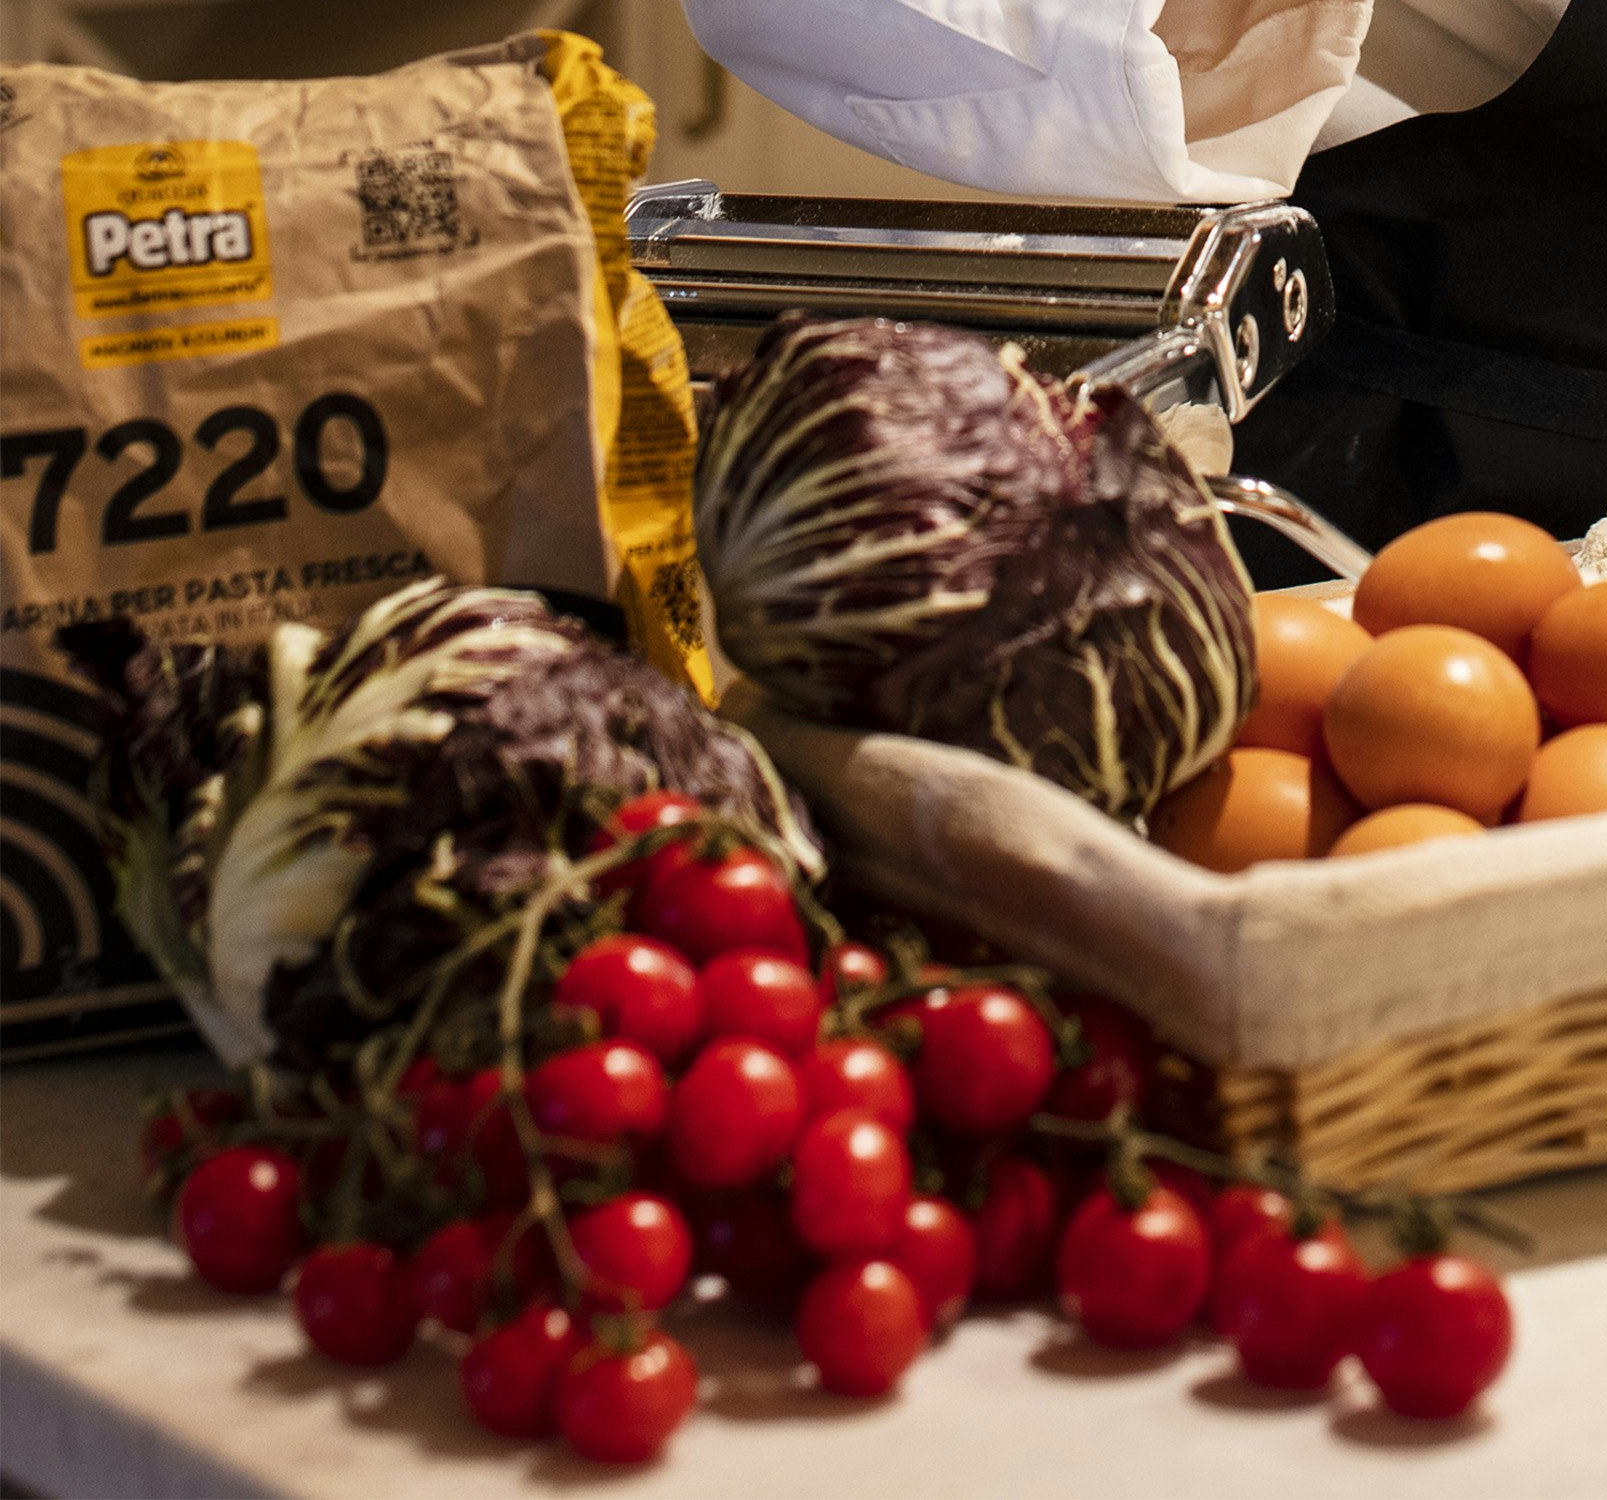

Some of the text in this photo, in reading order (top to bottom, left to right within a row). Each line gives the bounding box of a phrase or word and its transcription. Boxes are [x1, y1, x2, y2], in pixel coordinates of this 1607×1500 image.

[86, 208, 252, 276] Petra
[0, 392, 387, 554] 7220
[111, 582, 176, 618] PER
[184, 567, 293, 606] PASTA
[302, 550, 433, 589] FRESCA
